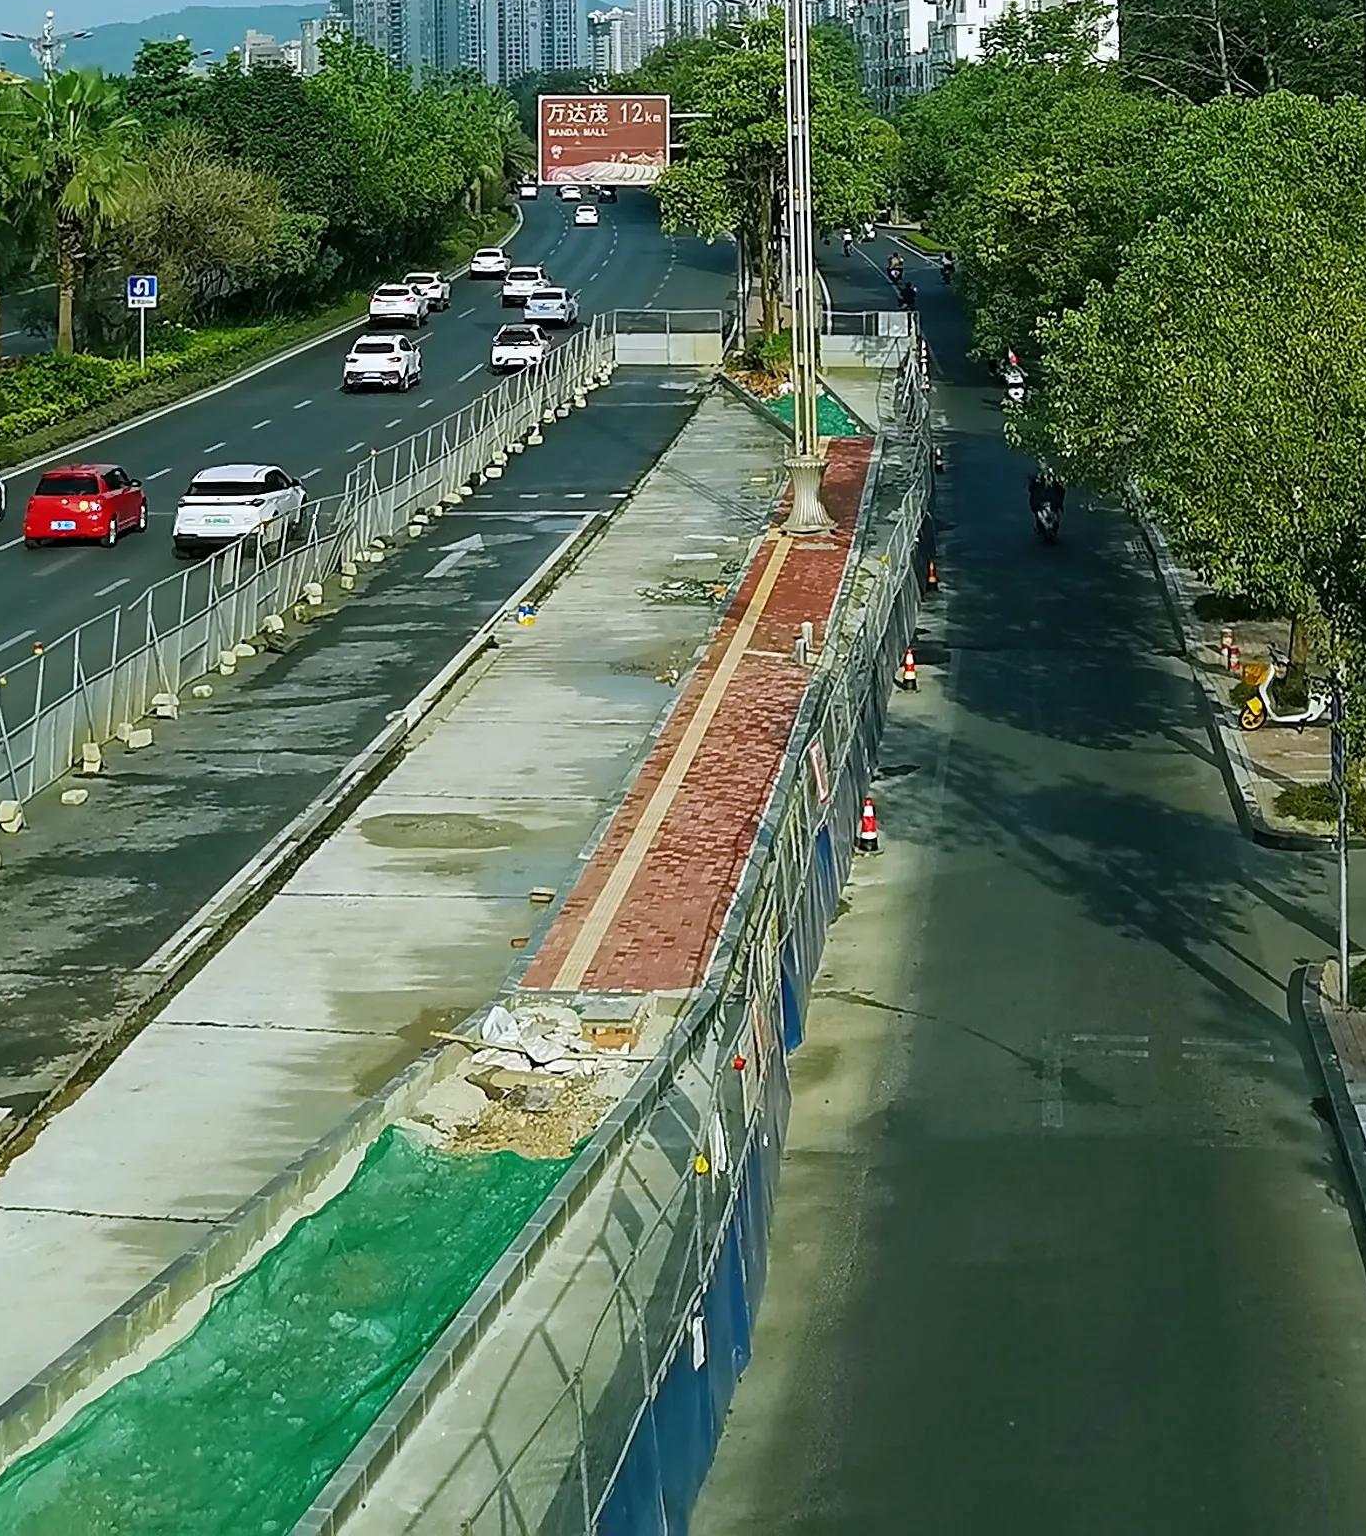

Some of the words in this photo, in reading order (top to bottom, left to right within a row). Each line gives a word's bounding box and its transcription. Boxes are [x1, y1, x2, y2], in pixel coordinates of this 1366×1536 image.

[546, 102, 608, 123] 万达茂
[547, 128, 579, 137] WANDA
[583, 128, 608, 137] MALL
